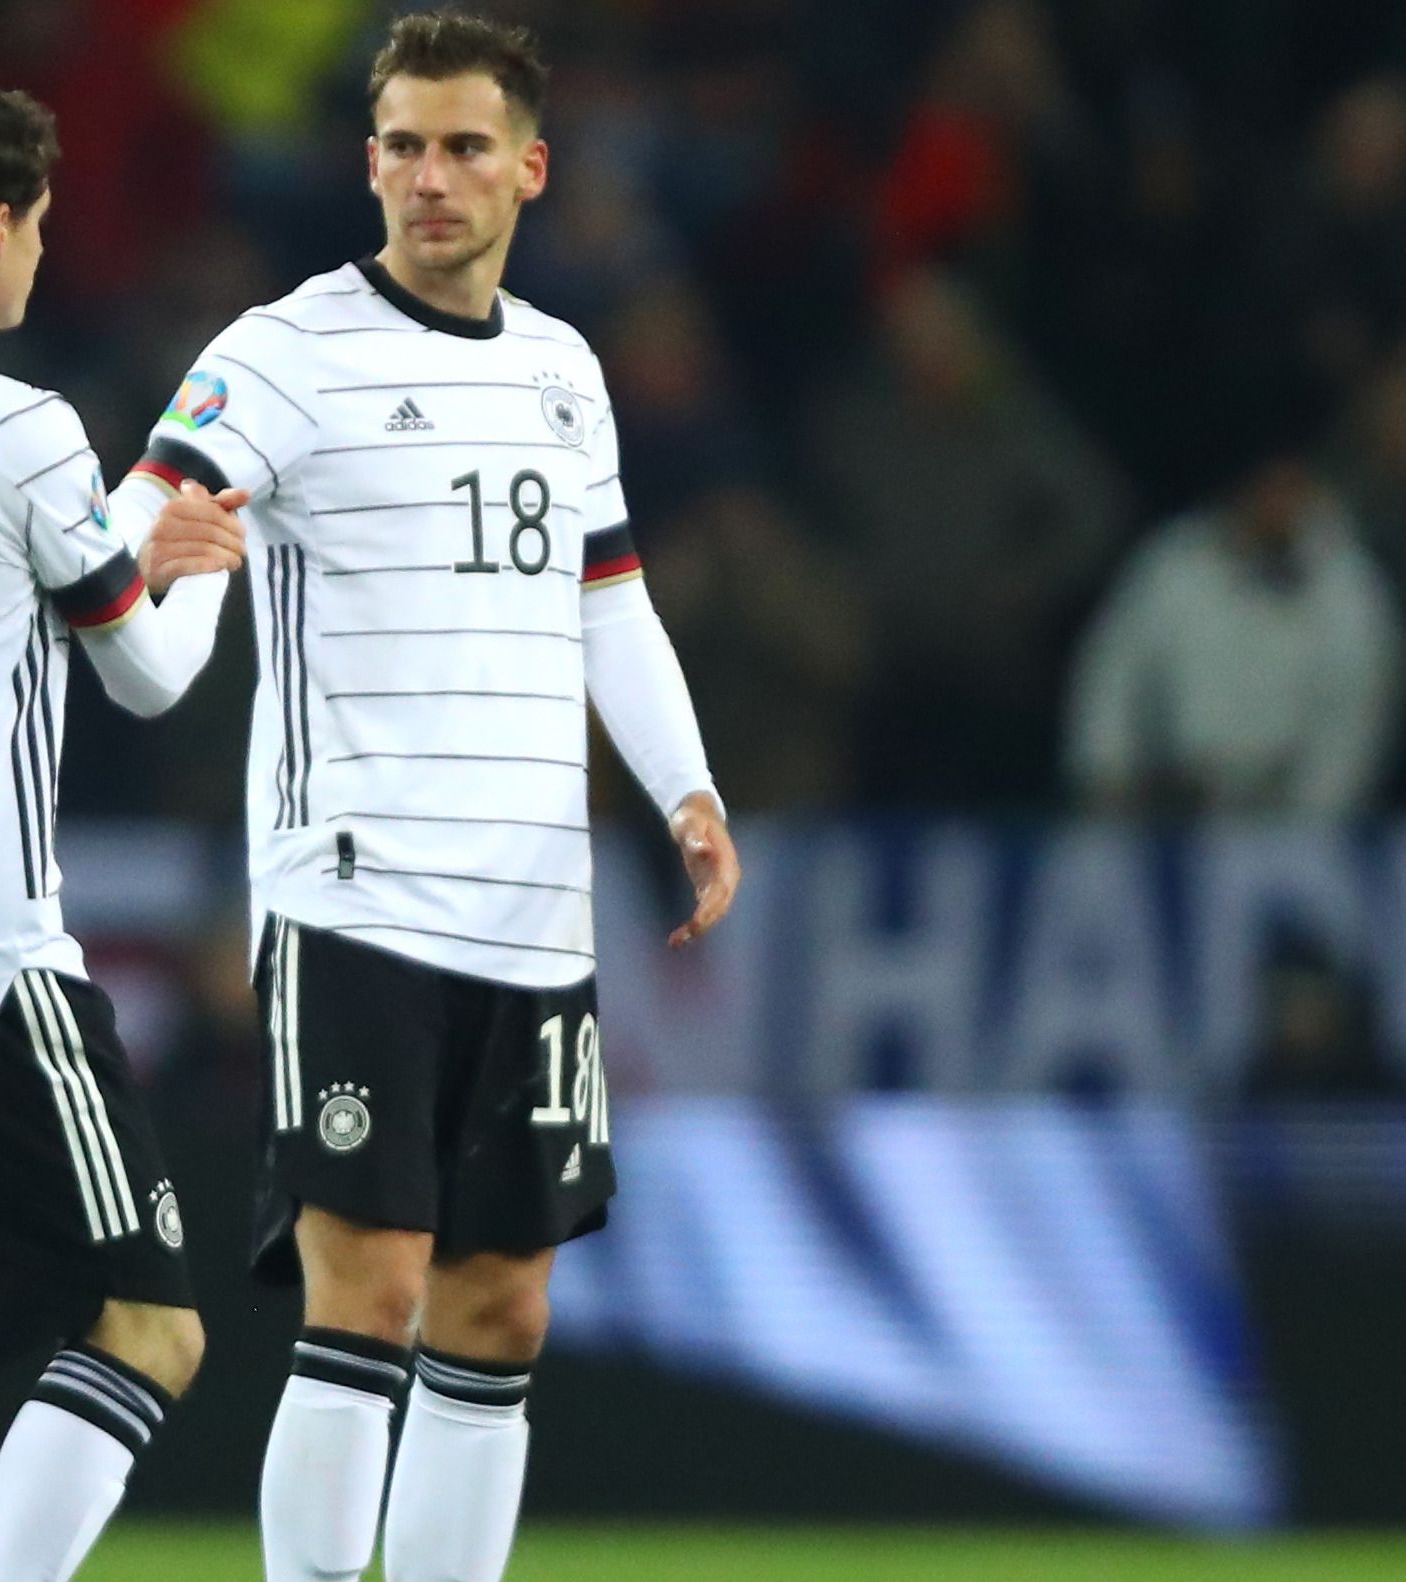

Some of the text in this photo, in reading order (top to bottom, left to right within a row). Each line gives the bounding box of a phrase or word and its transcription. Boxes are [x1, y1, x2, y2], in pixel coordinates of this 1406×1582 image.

[384, 418, 435, 432] adidas
[451, 469, 551, 576] 18
[530, 1012, 595, 1124] 18
